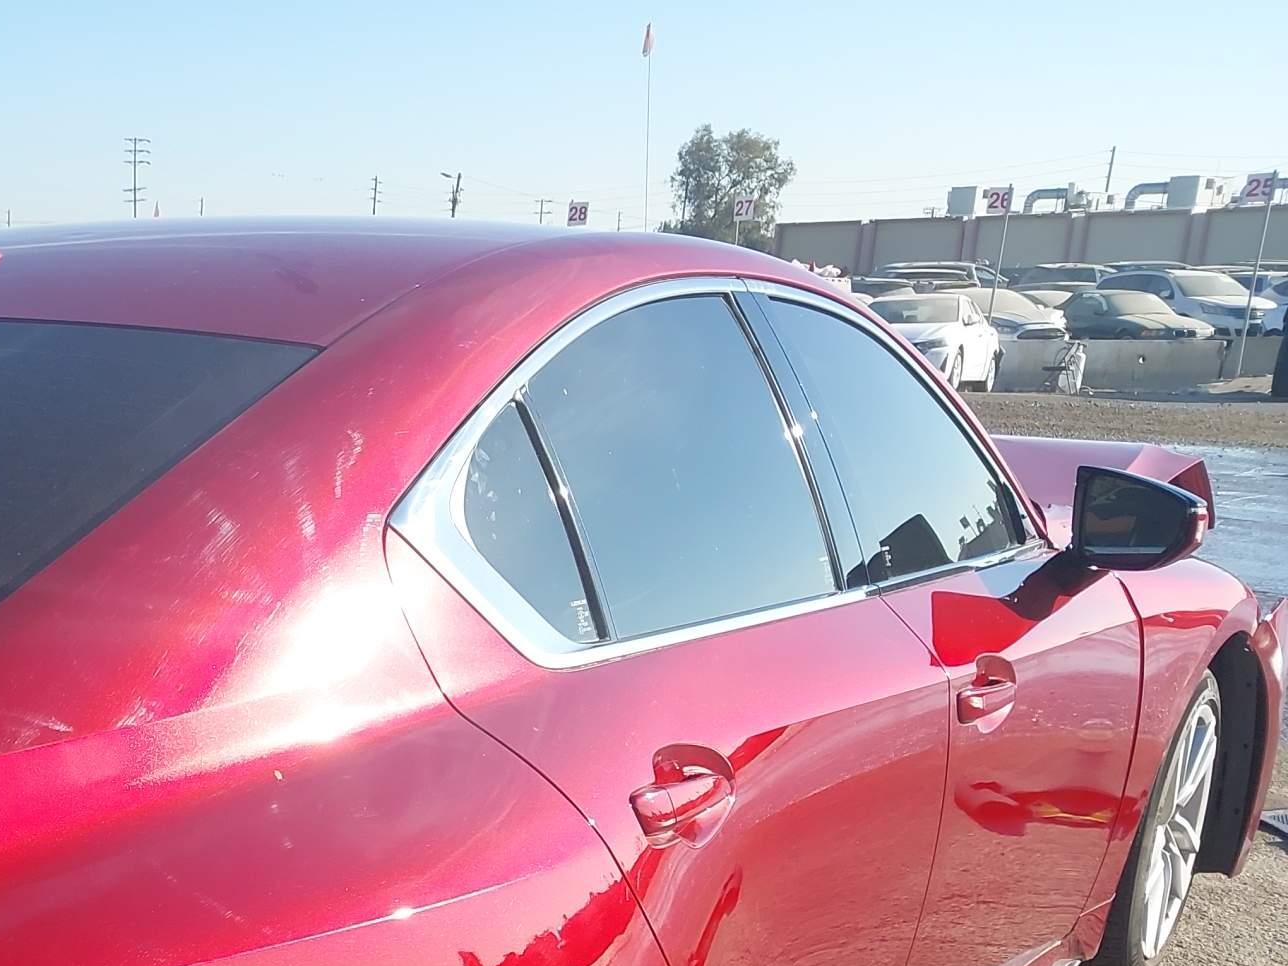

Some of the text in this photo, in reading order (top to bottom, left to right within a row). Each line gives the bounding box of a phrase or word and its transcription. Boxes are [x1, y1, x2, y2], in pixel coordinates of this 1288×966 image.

[1245, 178, 1272, 198] 25
[568, 206, 588, 221] 28
[735, 200, 753, 216] 27
